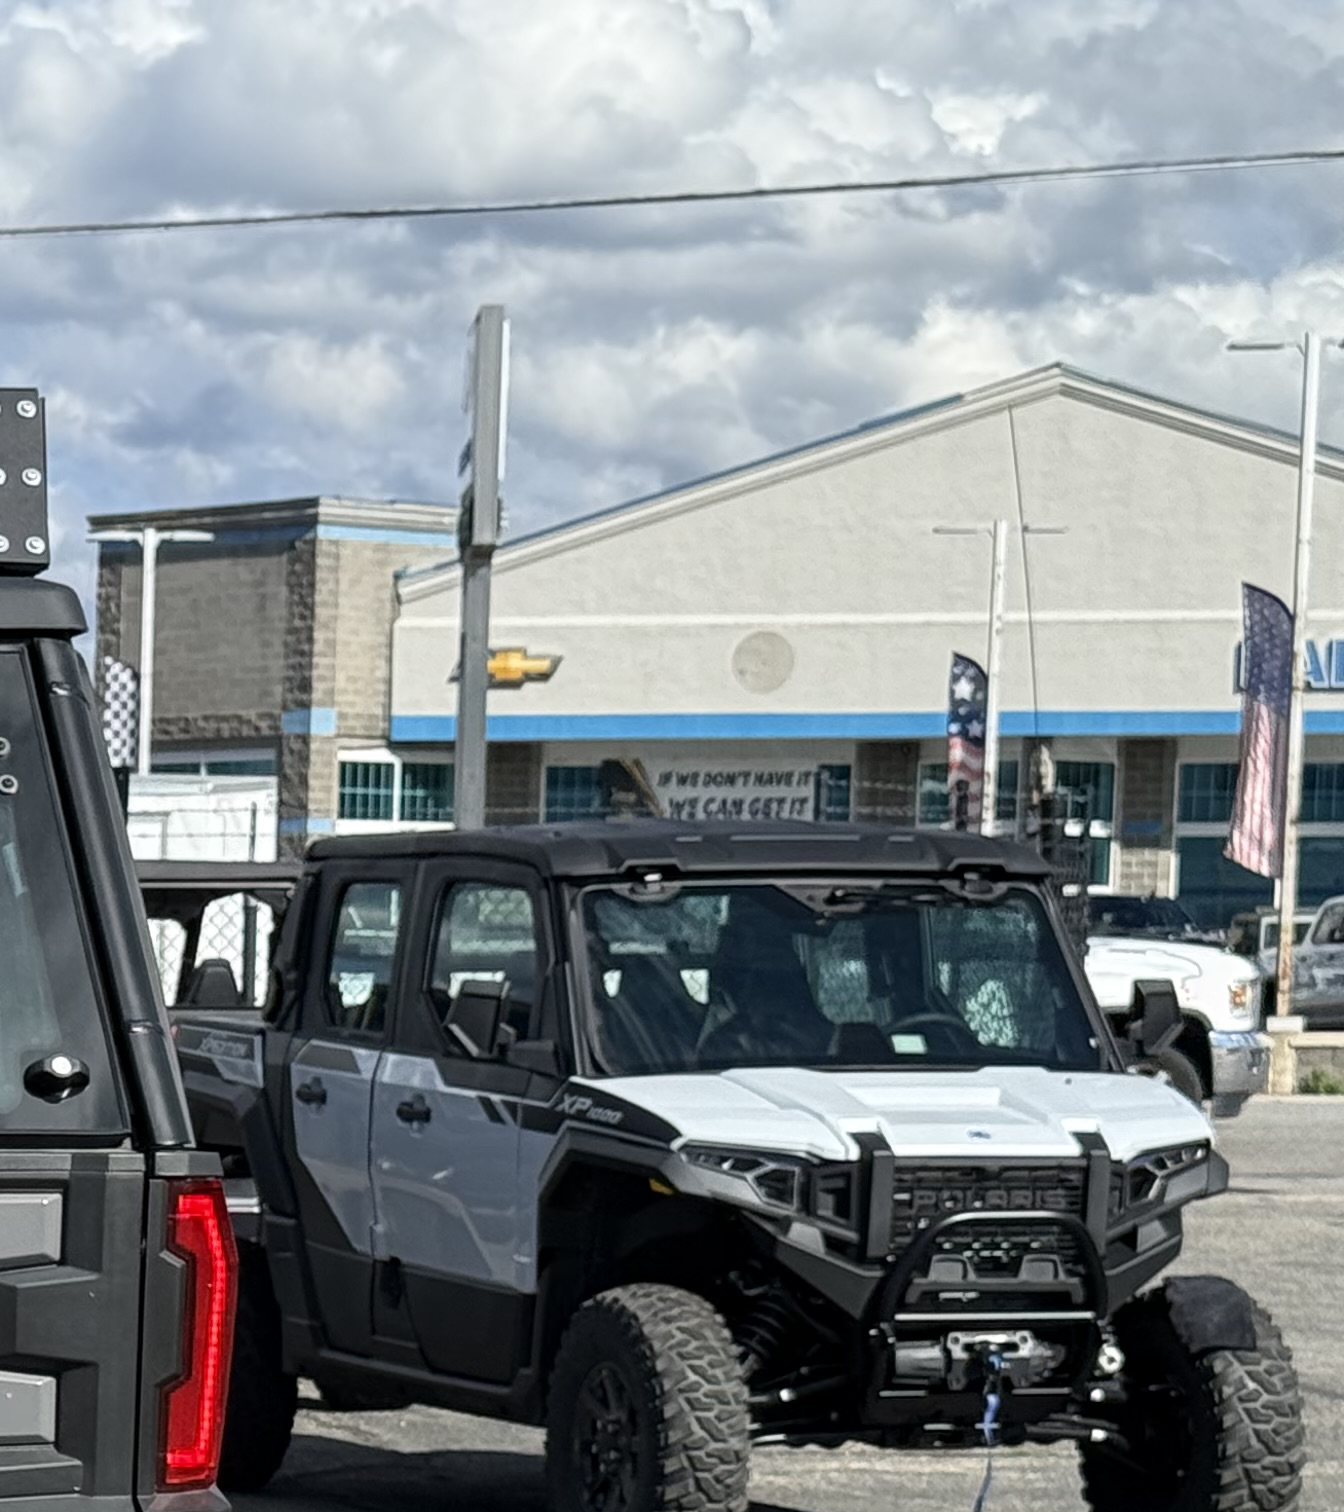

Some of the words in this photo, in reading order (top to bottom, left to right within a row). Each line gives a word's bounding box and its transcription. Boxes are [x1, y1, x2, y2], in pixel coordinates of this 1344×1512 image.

[657, 771, 673, 787] IF
[675, 771, 700, 787] WE
[702, 770, 751, 788] DON'T
[753, 771, 794, 788] HAVE
[796, 771, 812, 787] IT
[669, 797, 699, 819] WE
[703, 797, 744, 818] CAN
[748, 797, 787, 818] GET
[789, 797, 810, 818] IT
[554, 1093, 592, 1114] XP
[586, 1106, 624, 1125] 1000
